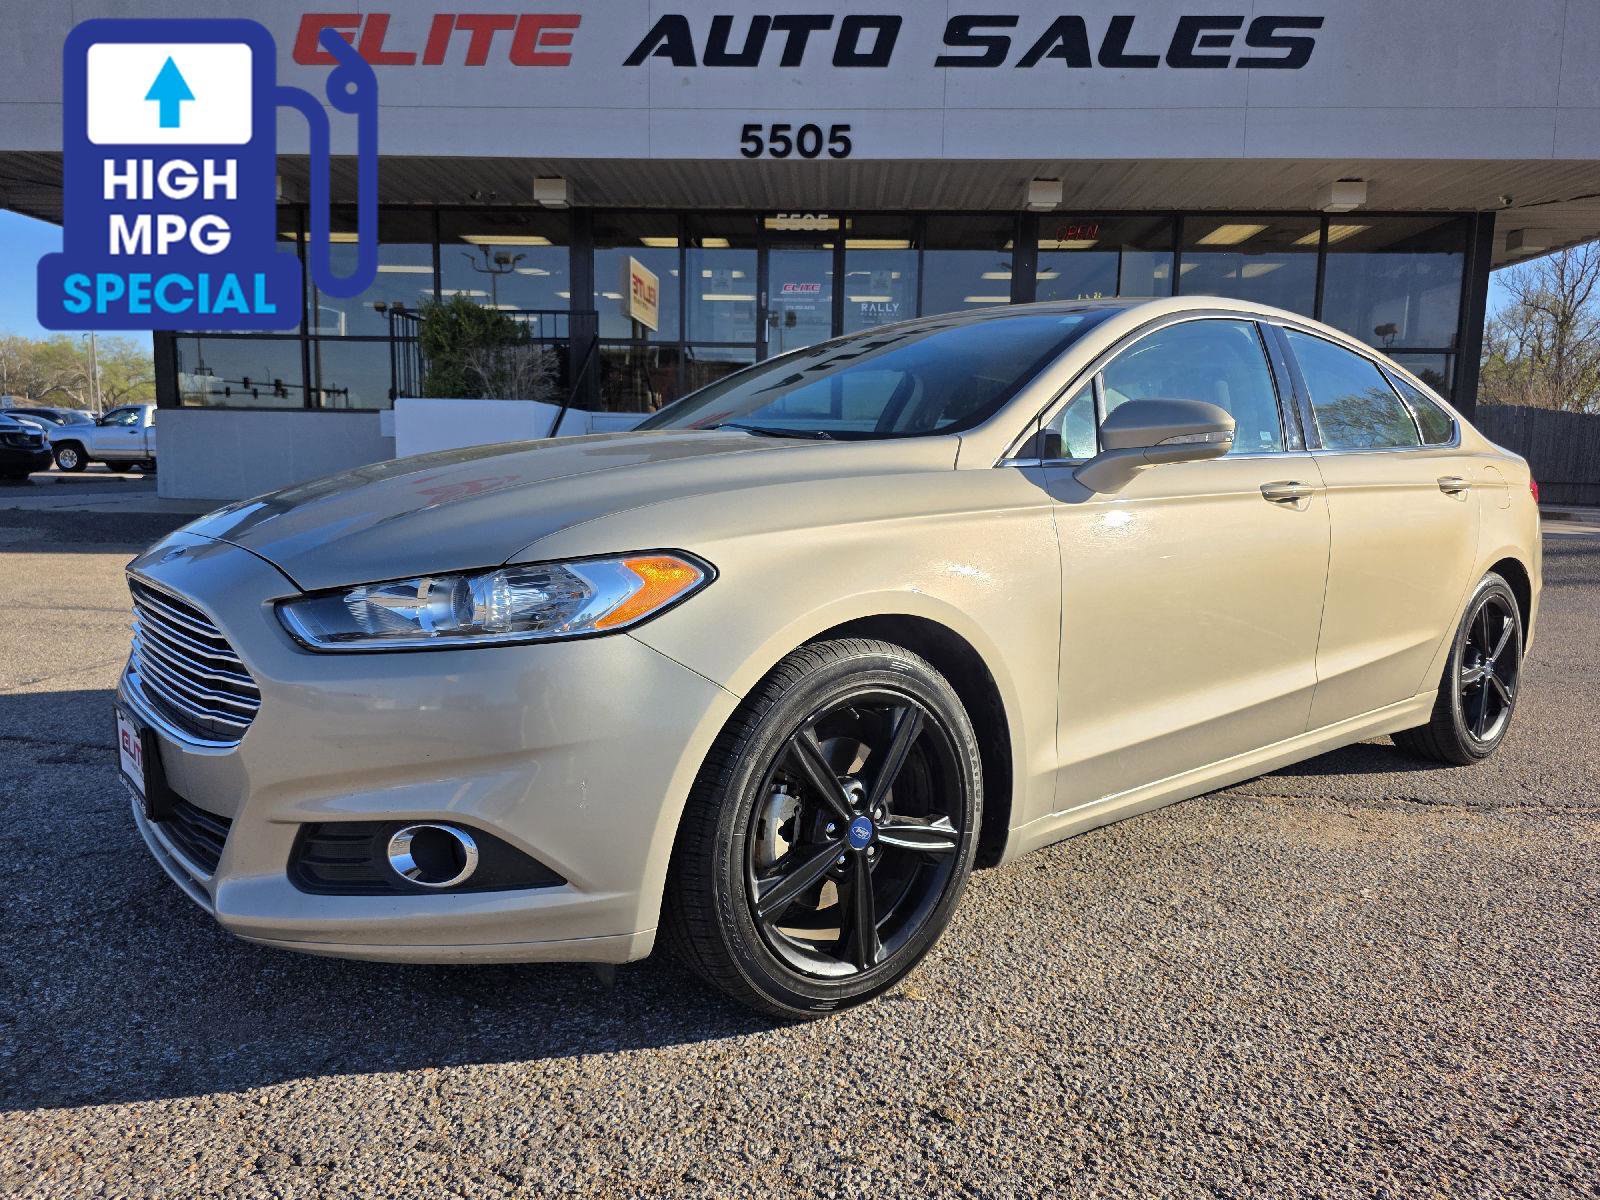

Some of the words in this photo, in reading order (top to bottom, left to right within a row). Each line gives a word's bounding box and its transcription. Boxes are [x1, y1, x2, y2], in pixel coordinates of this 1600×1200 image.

[293, 14, 581, 66] ELITE
[622, 14, 903, 68] AUTO
[935, 14, 1324, 69] SALES
[740, 123, 852, 158] 5505
[1055, 224, 1099, 242] OPEN
[783, 283, 821, 292] ELITE
[861, 303, 900, 312] RALLY
